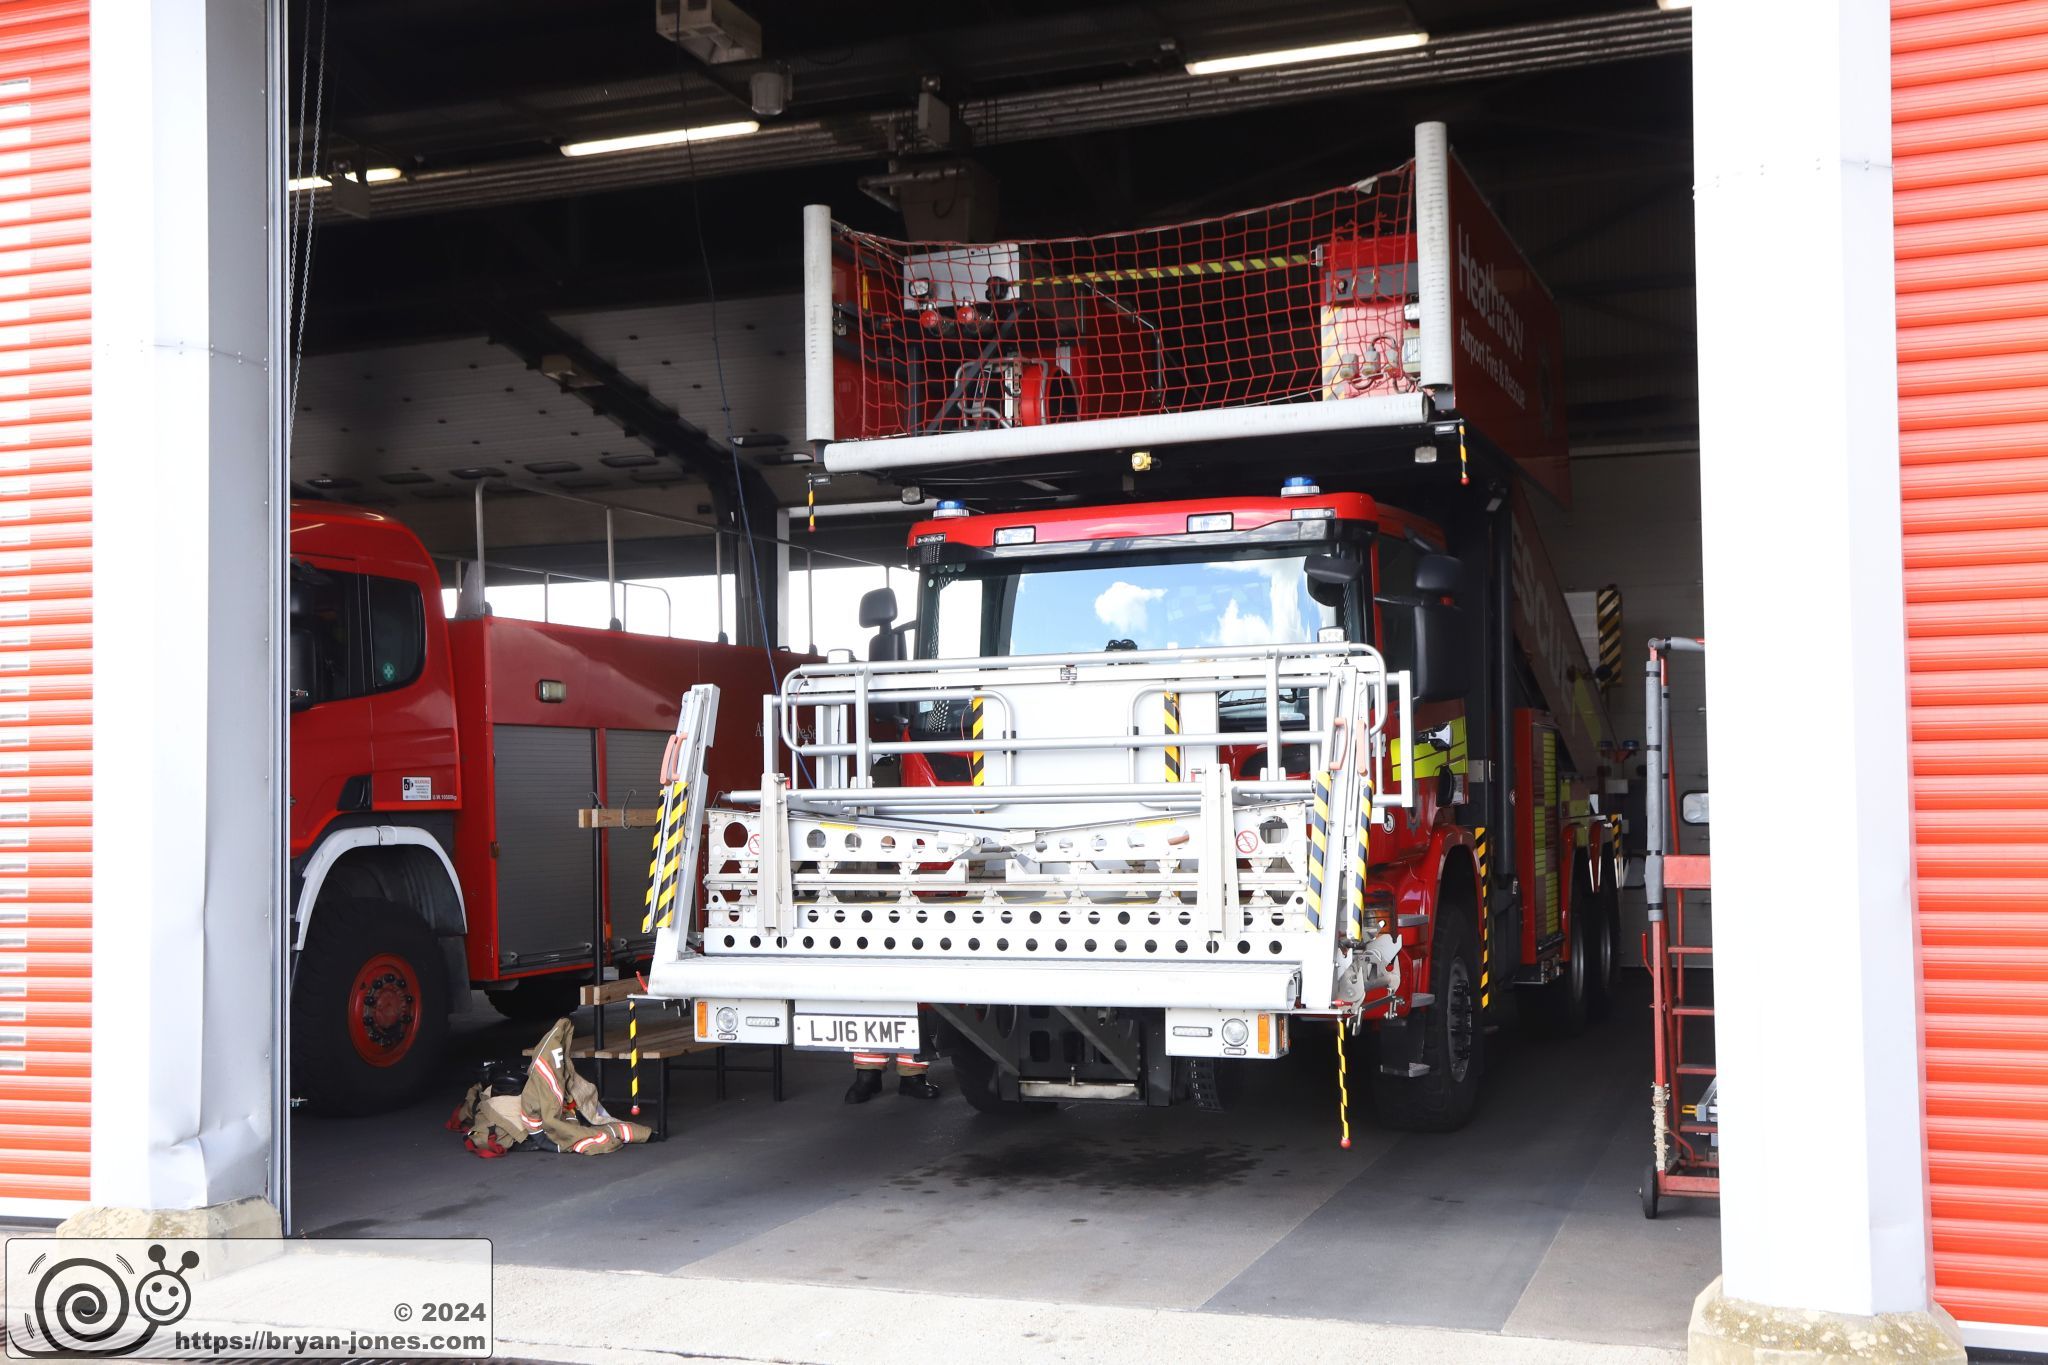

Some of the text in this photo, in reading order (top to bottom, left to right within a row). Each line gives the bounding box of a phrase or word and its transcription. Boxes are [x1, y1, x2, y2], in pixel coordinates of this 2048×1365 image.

[1458, 223, 1524, 361] Heathrow
[1460, 317, 1485, 369] Airport
[1486, 346, 1499, 383] Fire
[810, 1020, 906, 1043] LJ16 KMF
